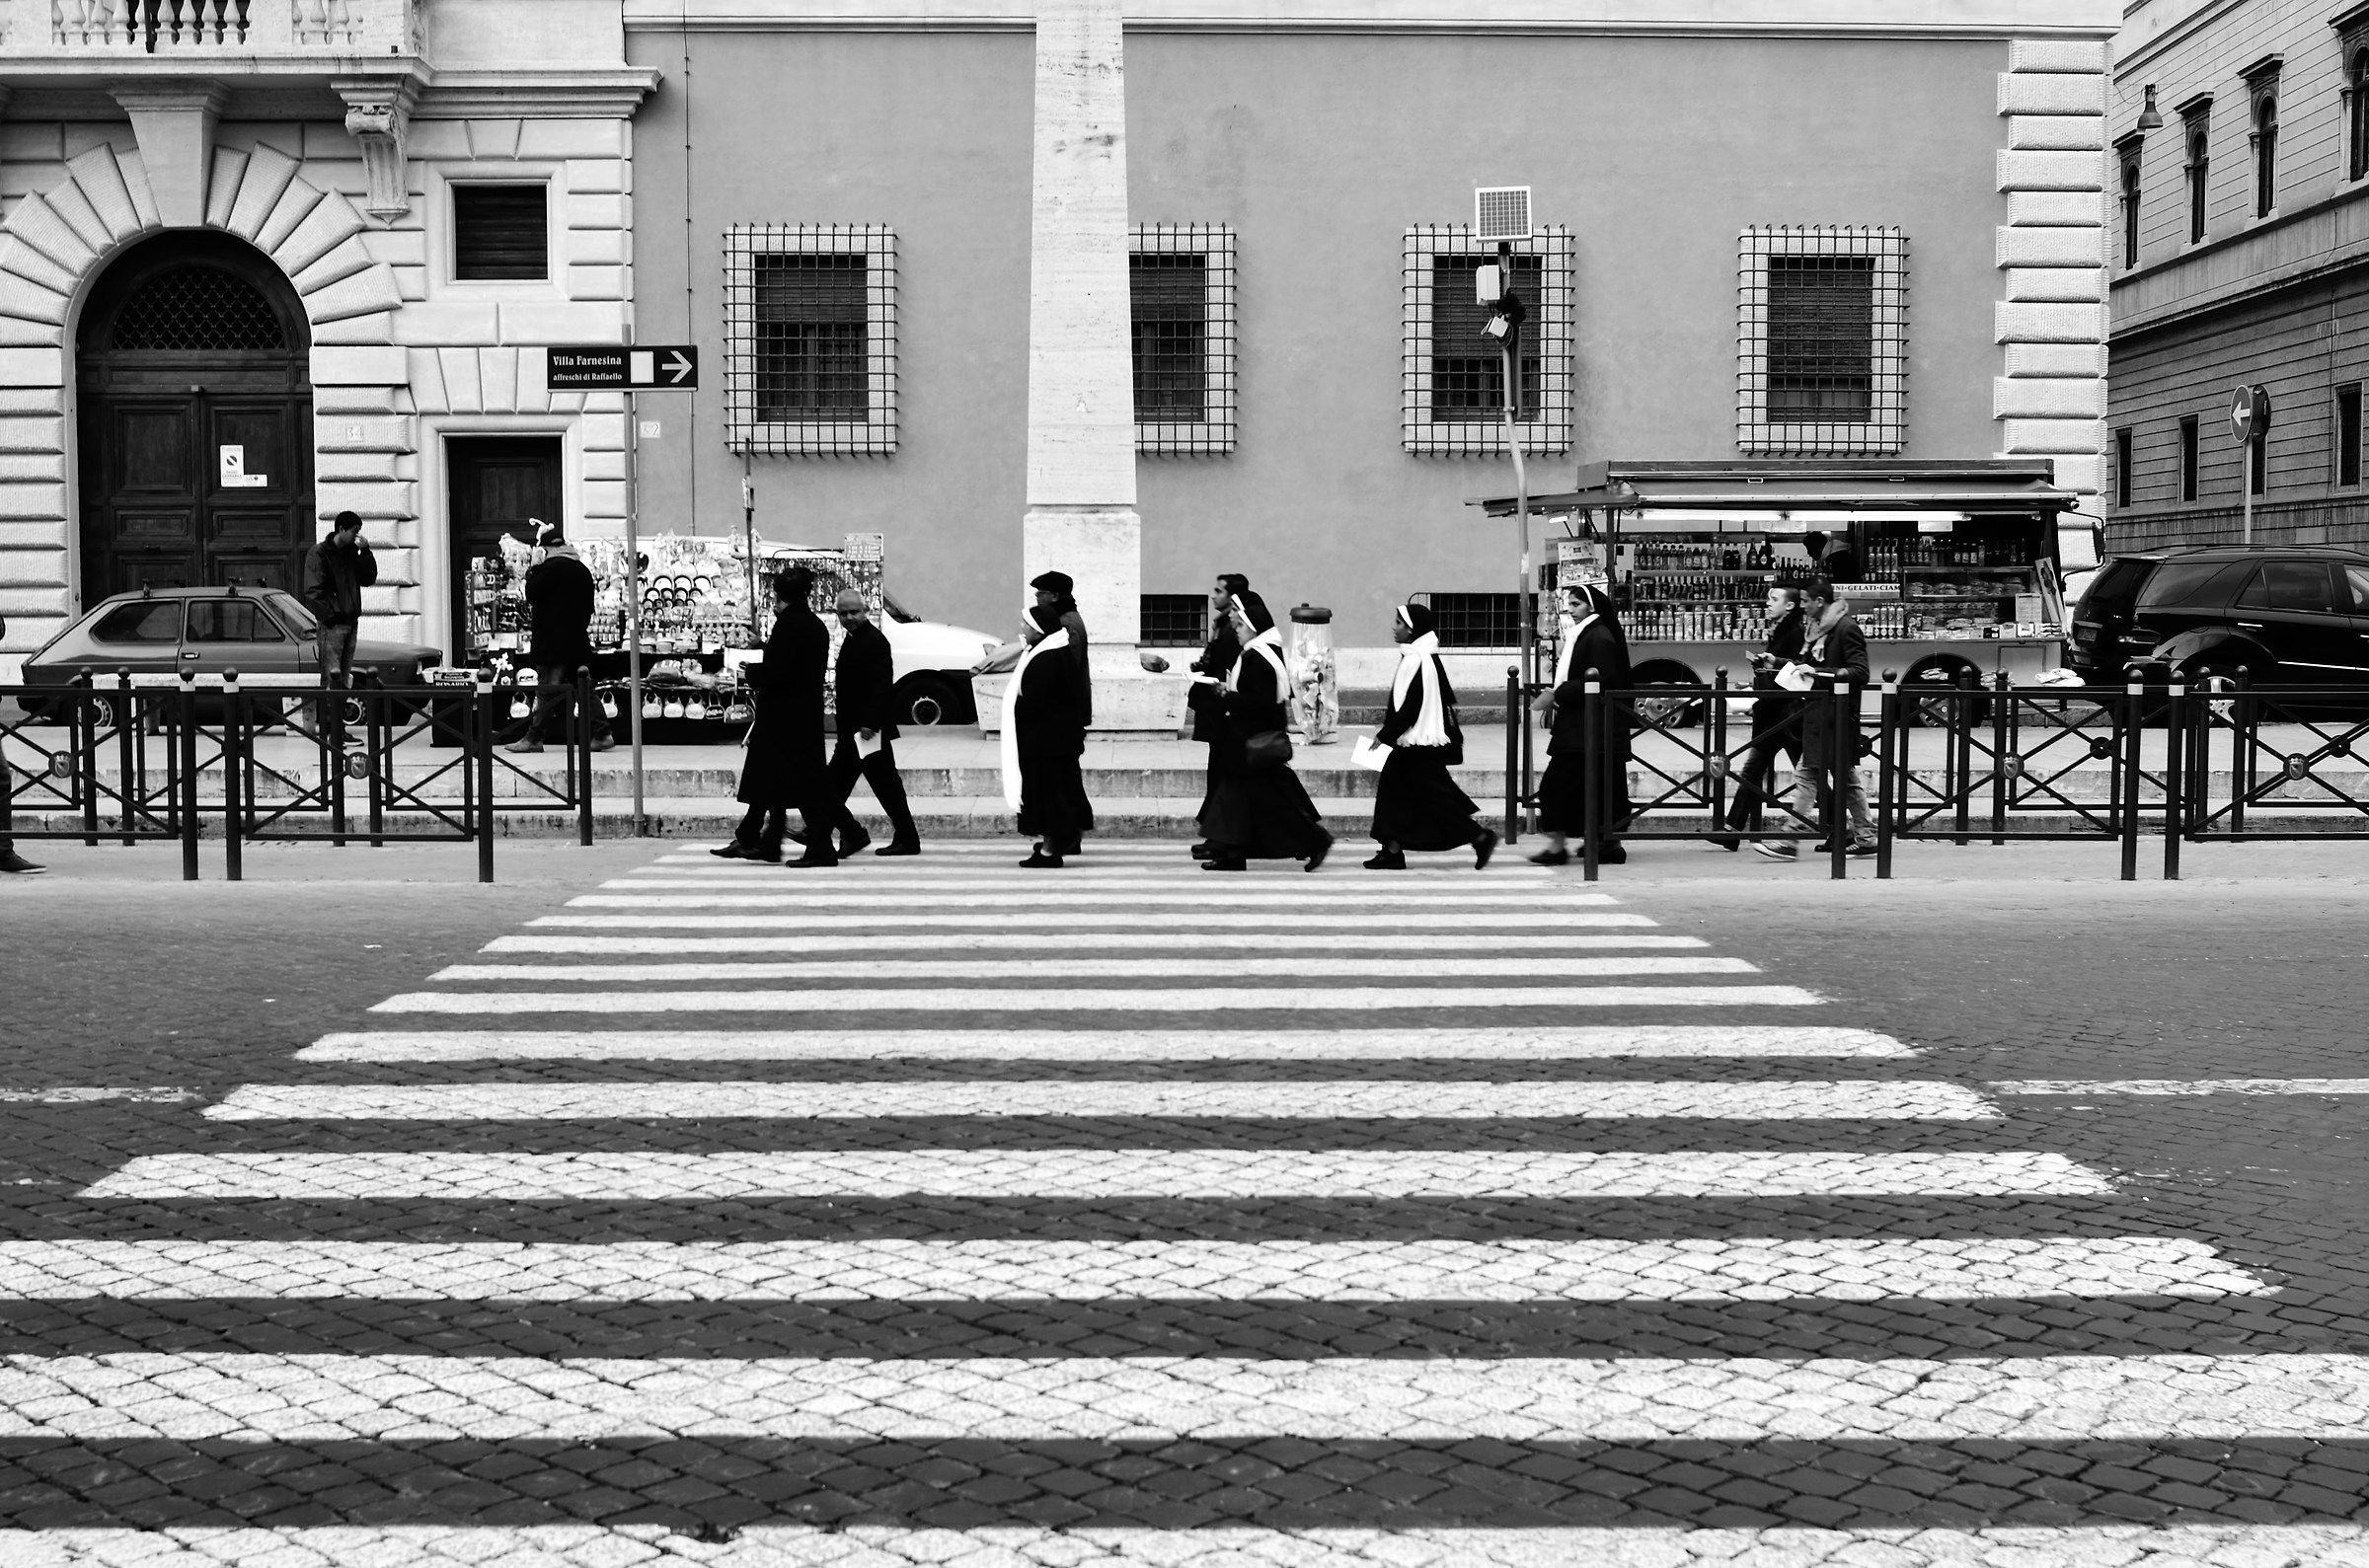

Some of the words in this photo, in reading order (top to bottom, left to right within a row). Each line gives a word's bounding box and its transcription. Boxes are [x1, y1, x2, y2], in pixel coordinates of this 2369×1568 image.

[553, 355, 574, 366] Villa
[576, 355, 622, 366] Farnesina
[591, 372, 623, 381] Raffaello
[347, 426, 364, 437] 34
